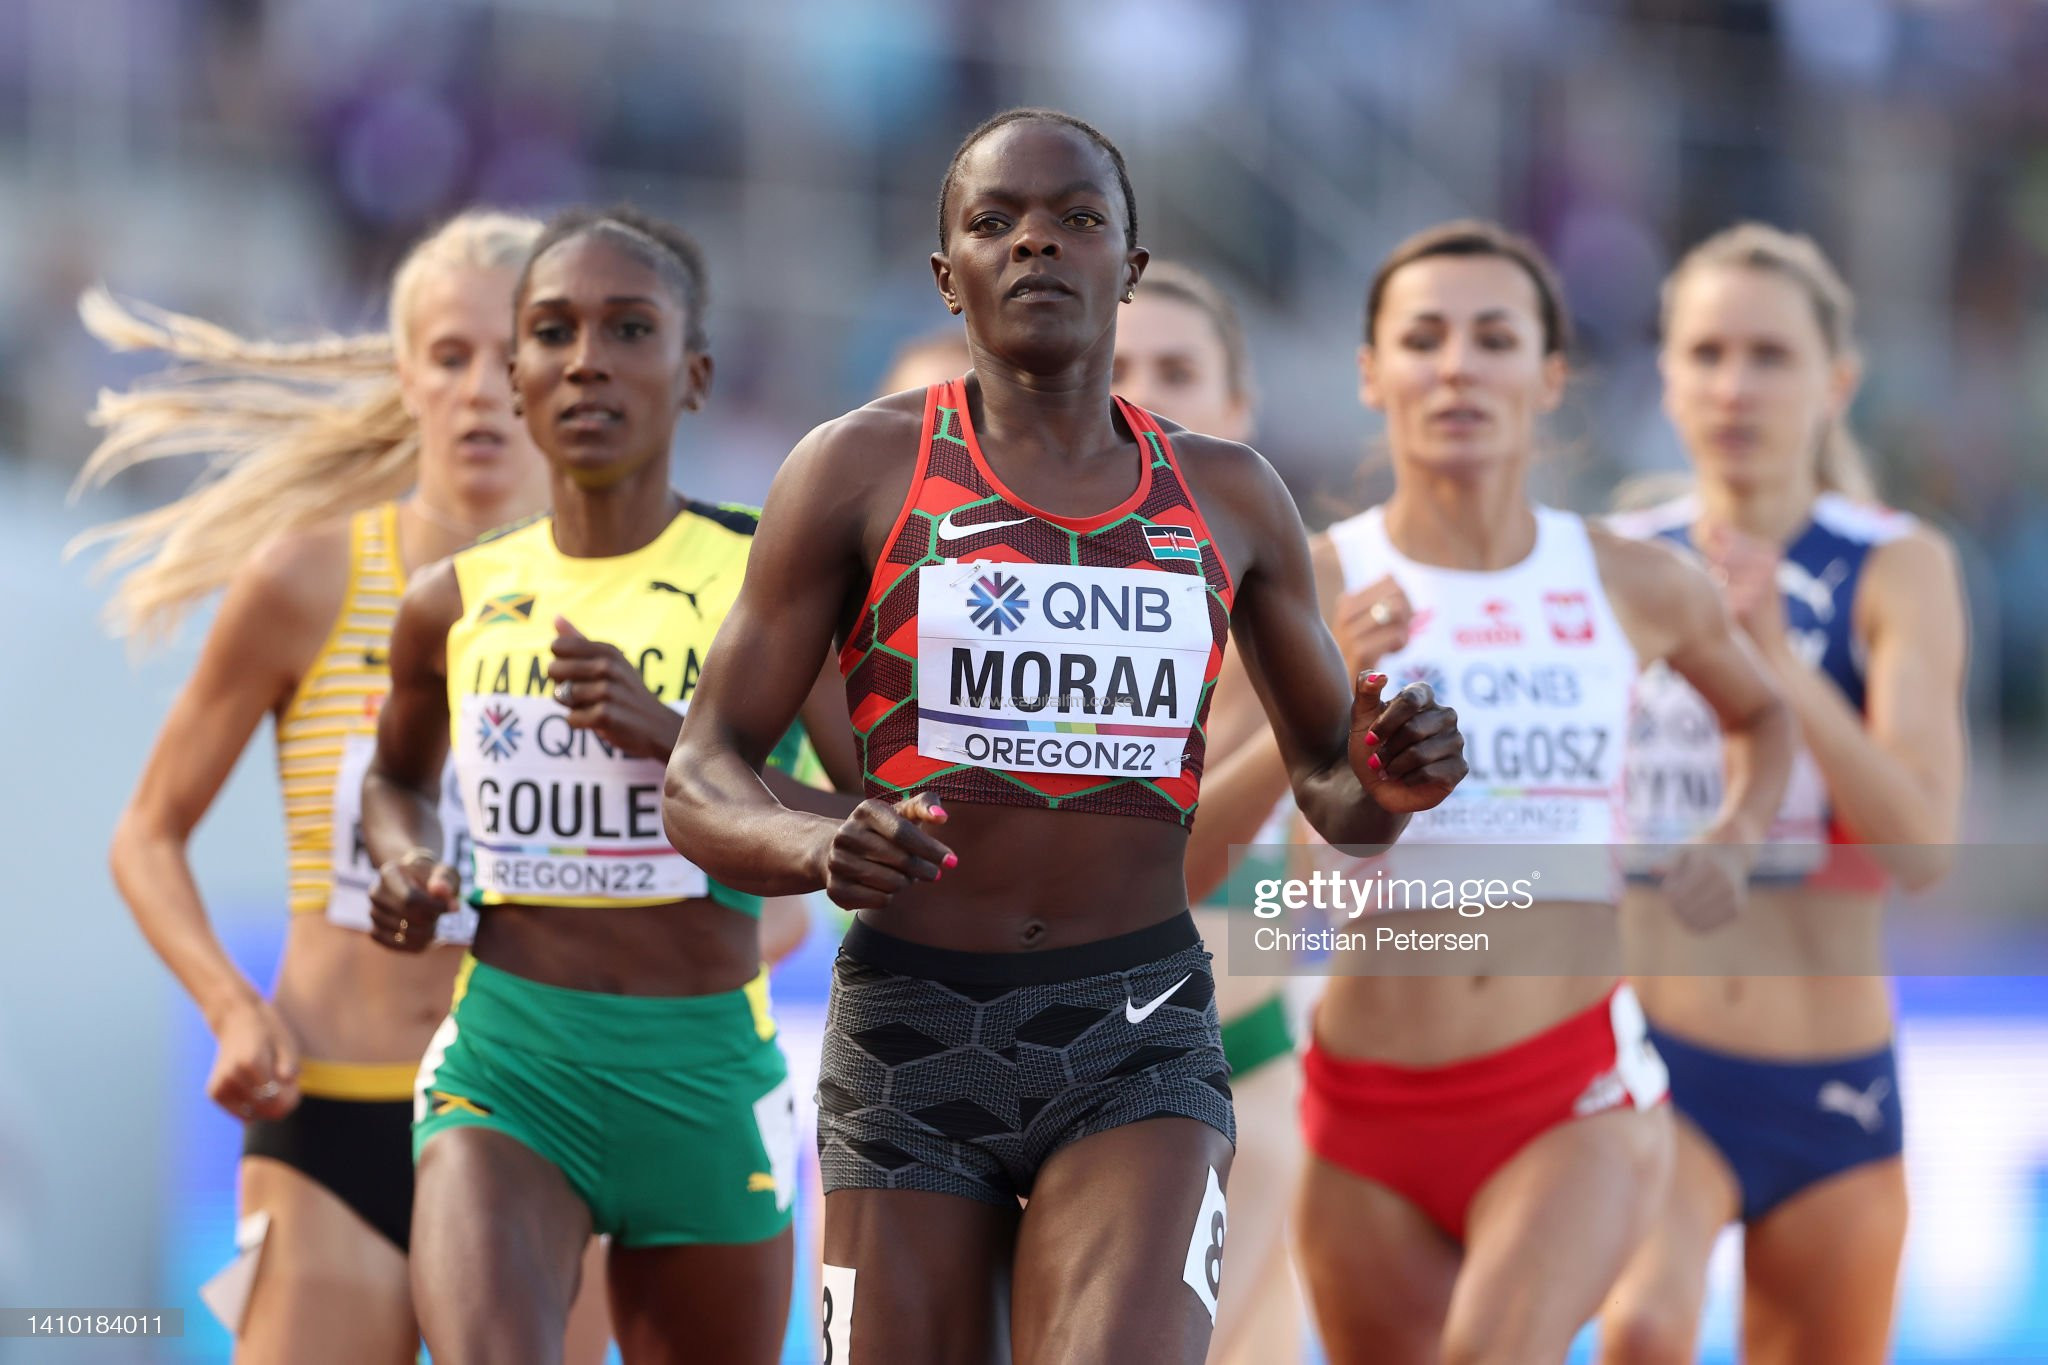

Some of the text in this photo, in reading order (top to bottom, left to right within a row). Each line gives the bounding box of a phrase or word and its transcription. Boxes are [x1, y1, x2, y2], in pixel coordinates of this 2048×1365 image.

[1042, 581, 1173, 633] QNB
[474, 646, 701, 696] JAMCA
[950, 647, 1178, 719] MORAA
[1463, 664, 1581, 708] QNB
[537, 714, 648, 759] QN
[964, 733, 1156, 771] OREGON22
[1466, 728, 1608, 780] LGOSZ
[479, 778, 658, 838] GOULE
[490, 860, 656, 890] REGON22
[1205, 1210, 1225, 1301] 8
